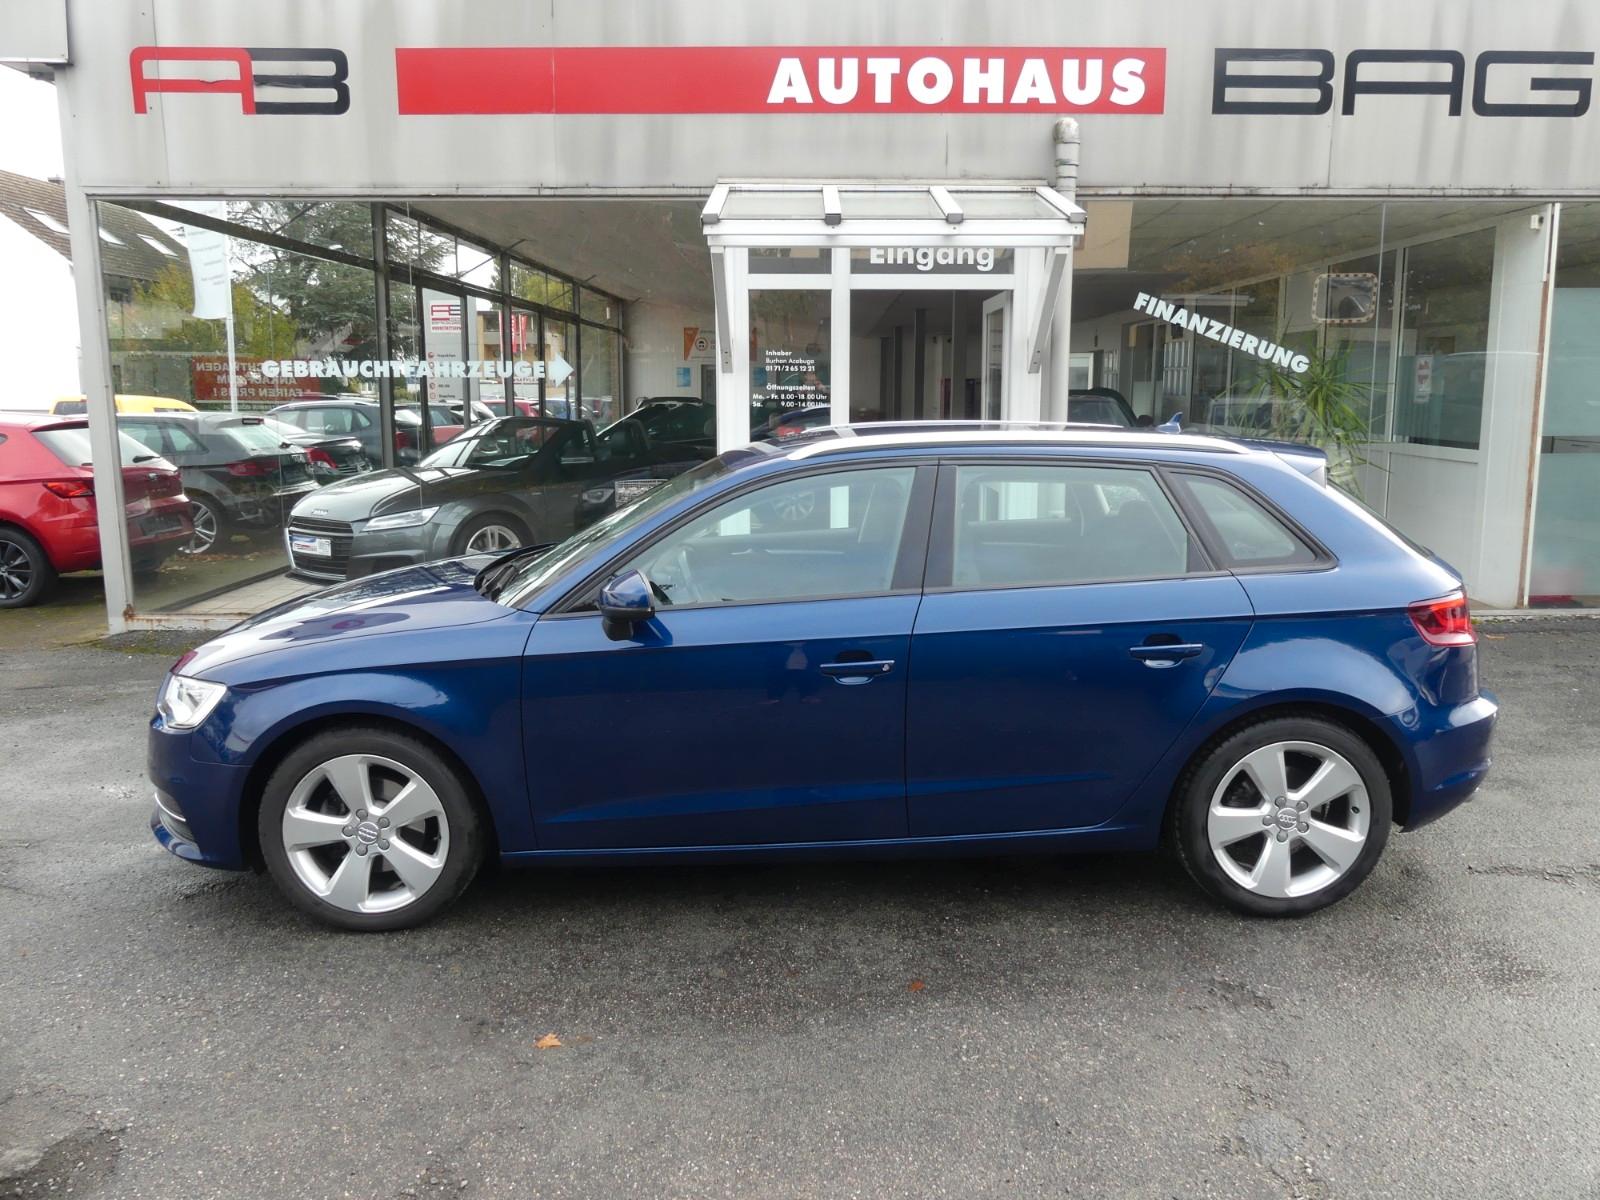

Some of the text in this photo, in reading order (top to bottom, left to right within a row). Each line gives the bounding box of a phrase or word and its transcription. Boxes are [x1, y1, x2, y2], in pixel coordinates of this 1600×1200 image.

[130, 47, 350, 115] AB
[766, 47, 1596, 118] AUTOHAUS BAG
[869, 248, 995, 272] Eingang
[1133, 292, 1310, 373] FINANZIERUNG
[261, 360, 546, 378] GEBRAUCHTFAHRZEUGE
[766, 382, 816, 392] Öffnungszeiten
